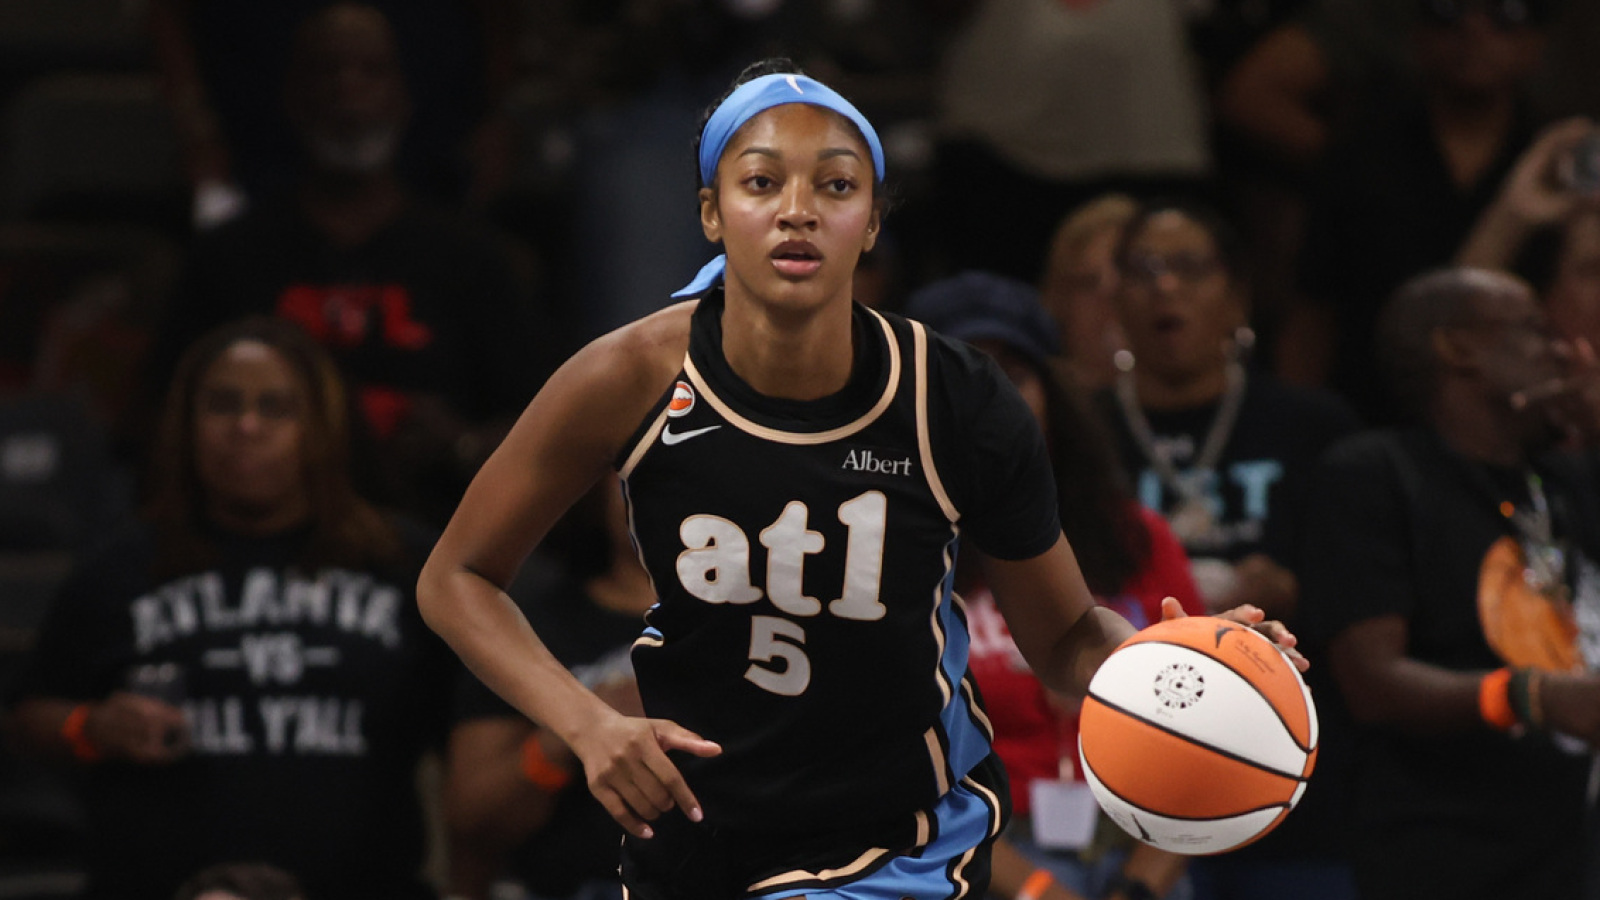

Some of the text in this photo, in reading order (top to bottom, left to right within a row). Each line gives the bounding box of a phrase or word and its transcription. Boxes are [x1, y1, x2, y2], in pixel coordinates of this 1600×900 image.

[842, 449, 912, 476] Albert
[675, 488, 888, 622] atl
[130, 566, 403, 655] ATLANTA
[744, 614, 812, 697] 5
